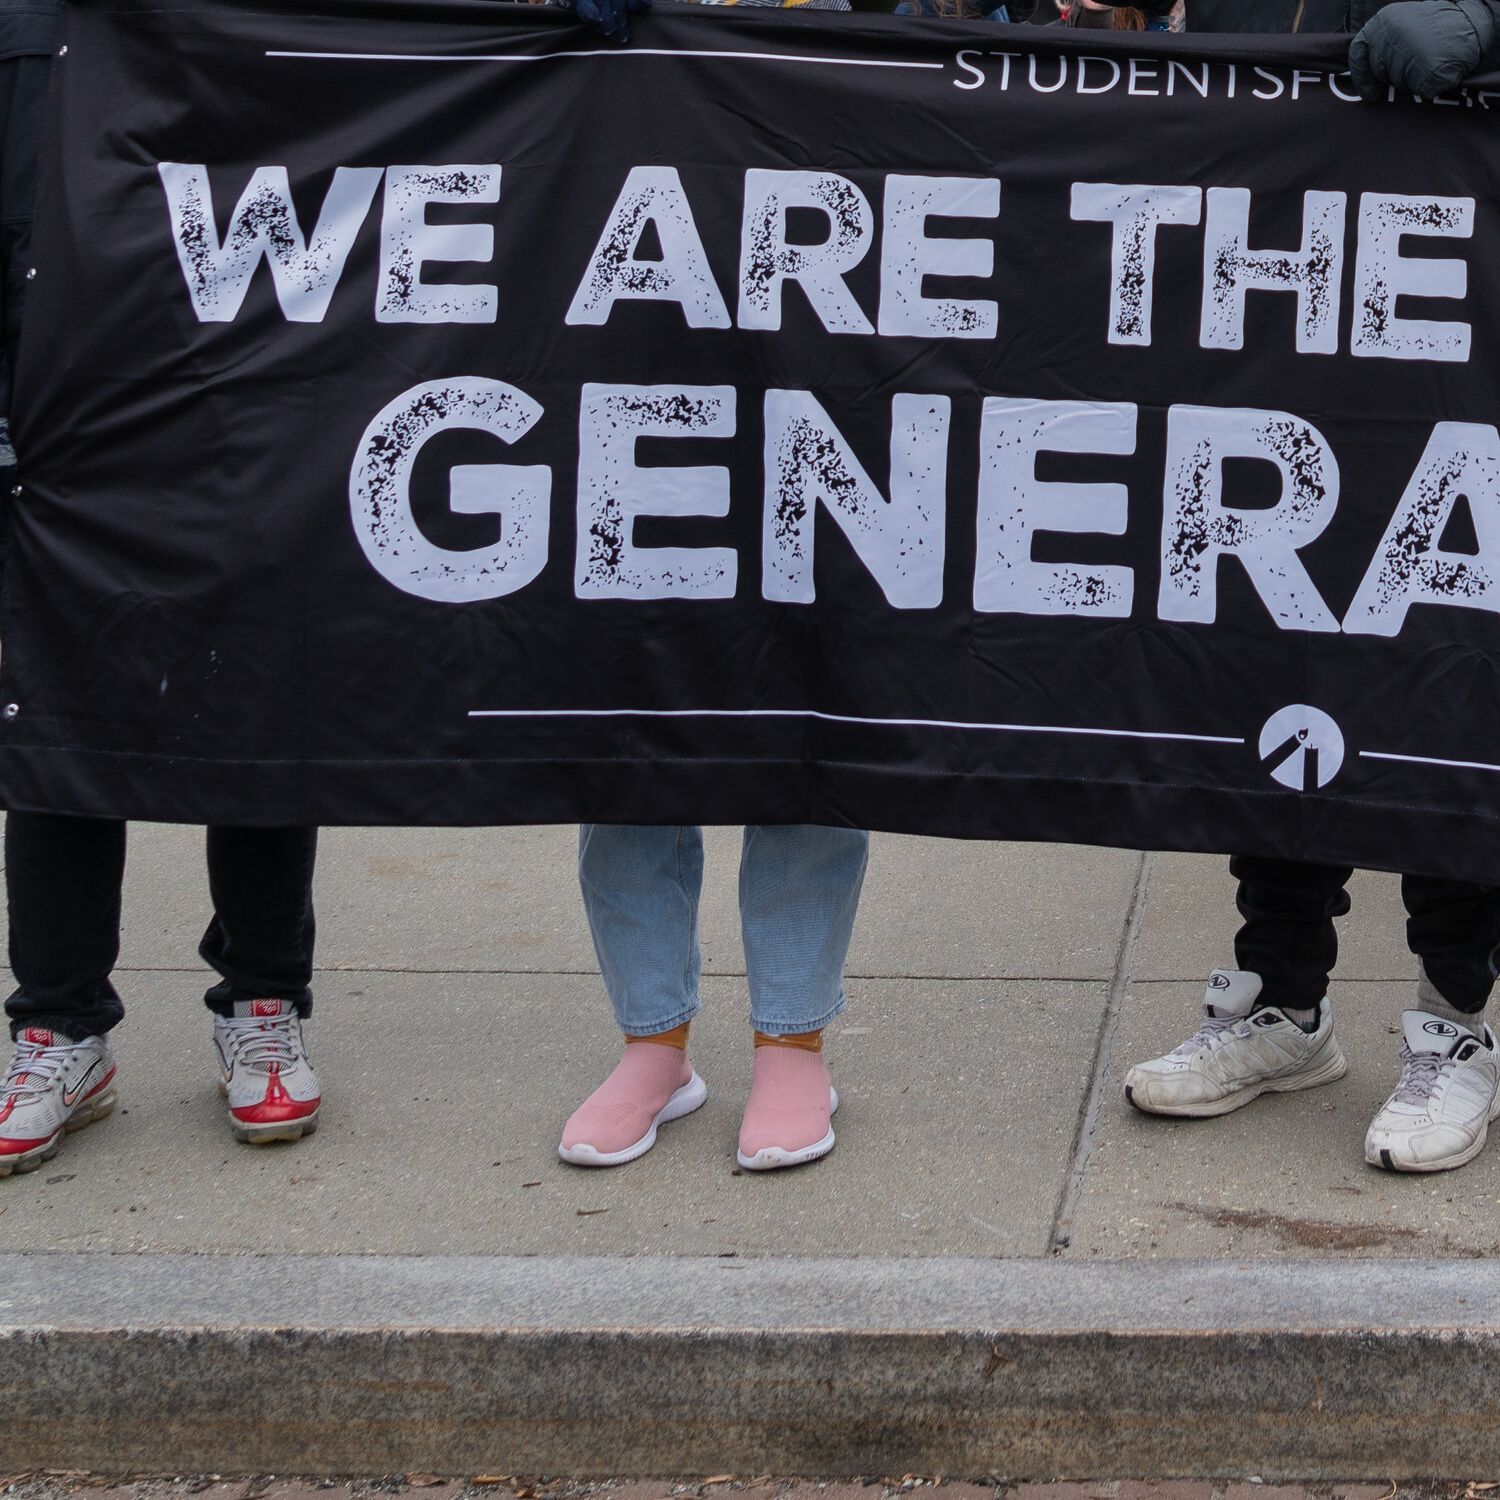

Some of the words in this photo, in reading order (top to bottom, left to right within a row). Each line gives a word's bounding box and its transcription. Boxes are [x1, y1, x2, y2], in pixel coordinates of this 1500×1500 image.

[157, 162, 502, 323] WE
[565, 166, 1000, 339] ARE
[1070, 182, 1475, 362] THE
